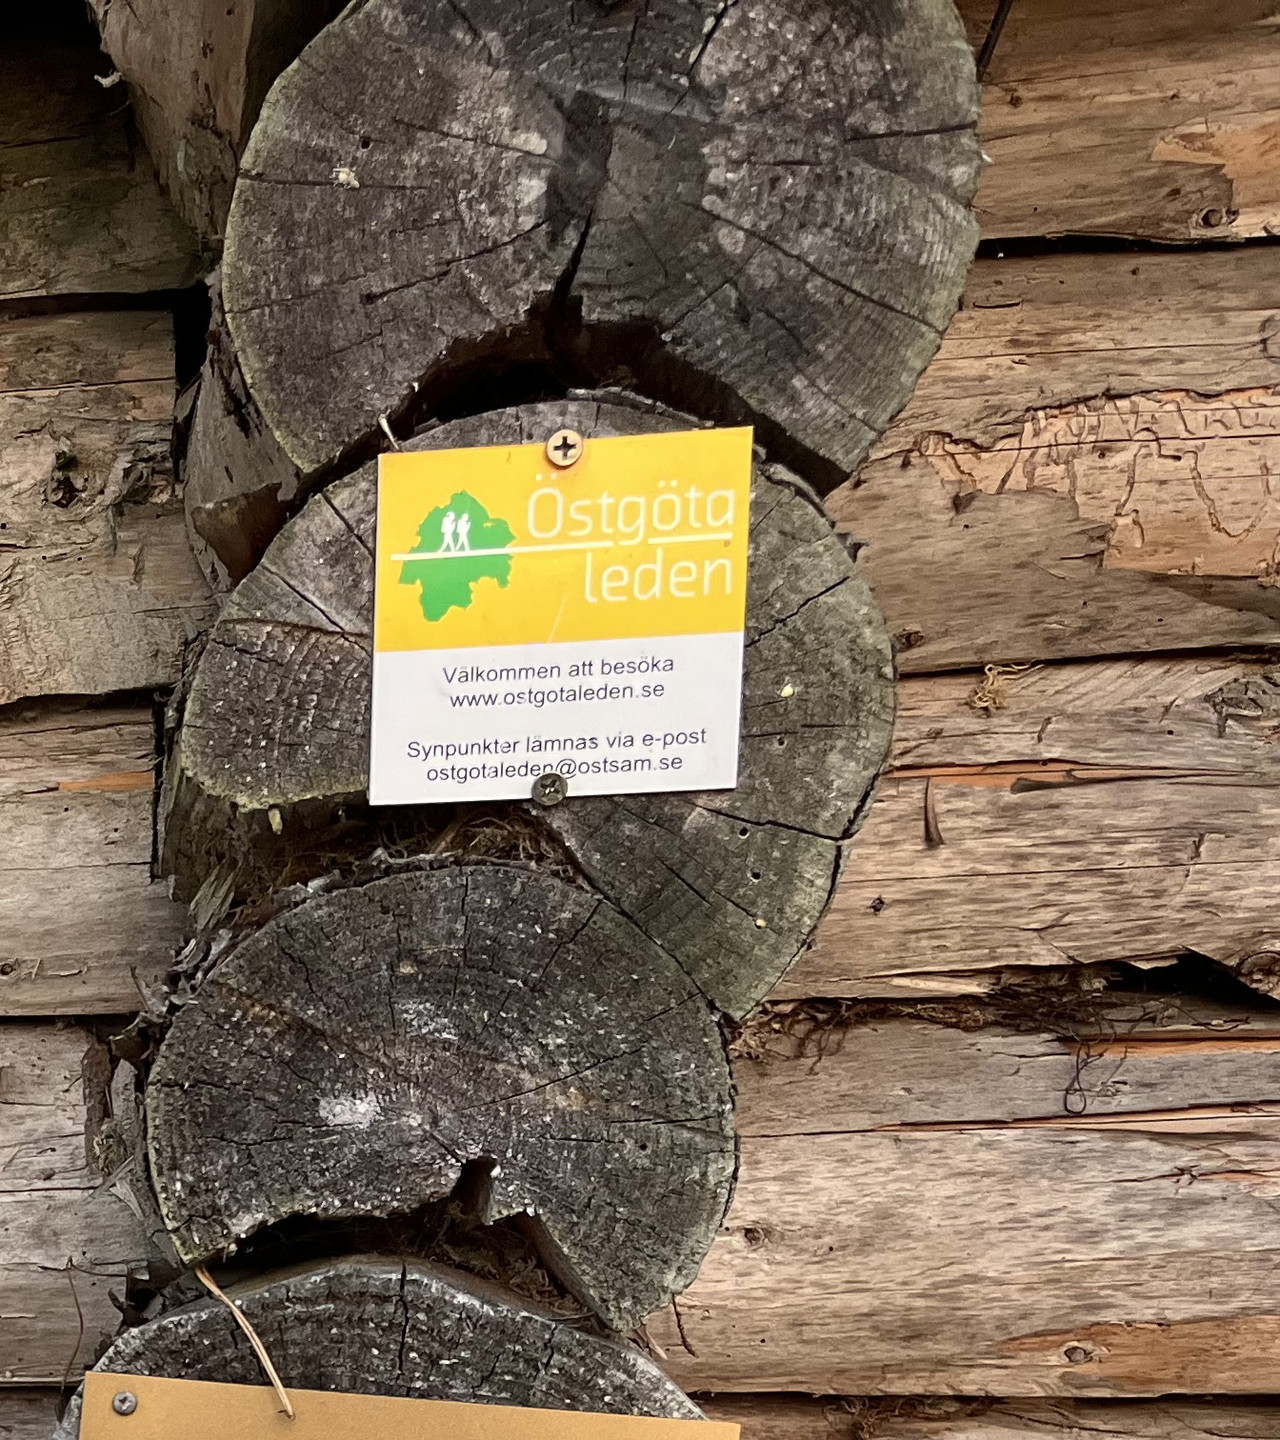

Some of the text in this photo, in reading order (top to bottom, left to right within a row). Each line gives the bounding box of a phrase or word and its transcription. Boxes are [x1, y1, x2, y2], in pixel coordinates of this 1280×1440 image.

[527, 473, 736, 546] Östgöta
[584, 548, 732, 603] leden
[443, 656, 673, 683] Välkommen att besöka
[450, 683, 664, 708] www.ostgotaleden.se
[407, 728, 706, 761] Synpunkter lämnas via e-post
[426, 755, 683, 783] ostgotaleden@ostsam.se
